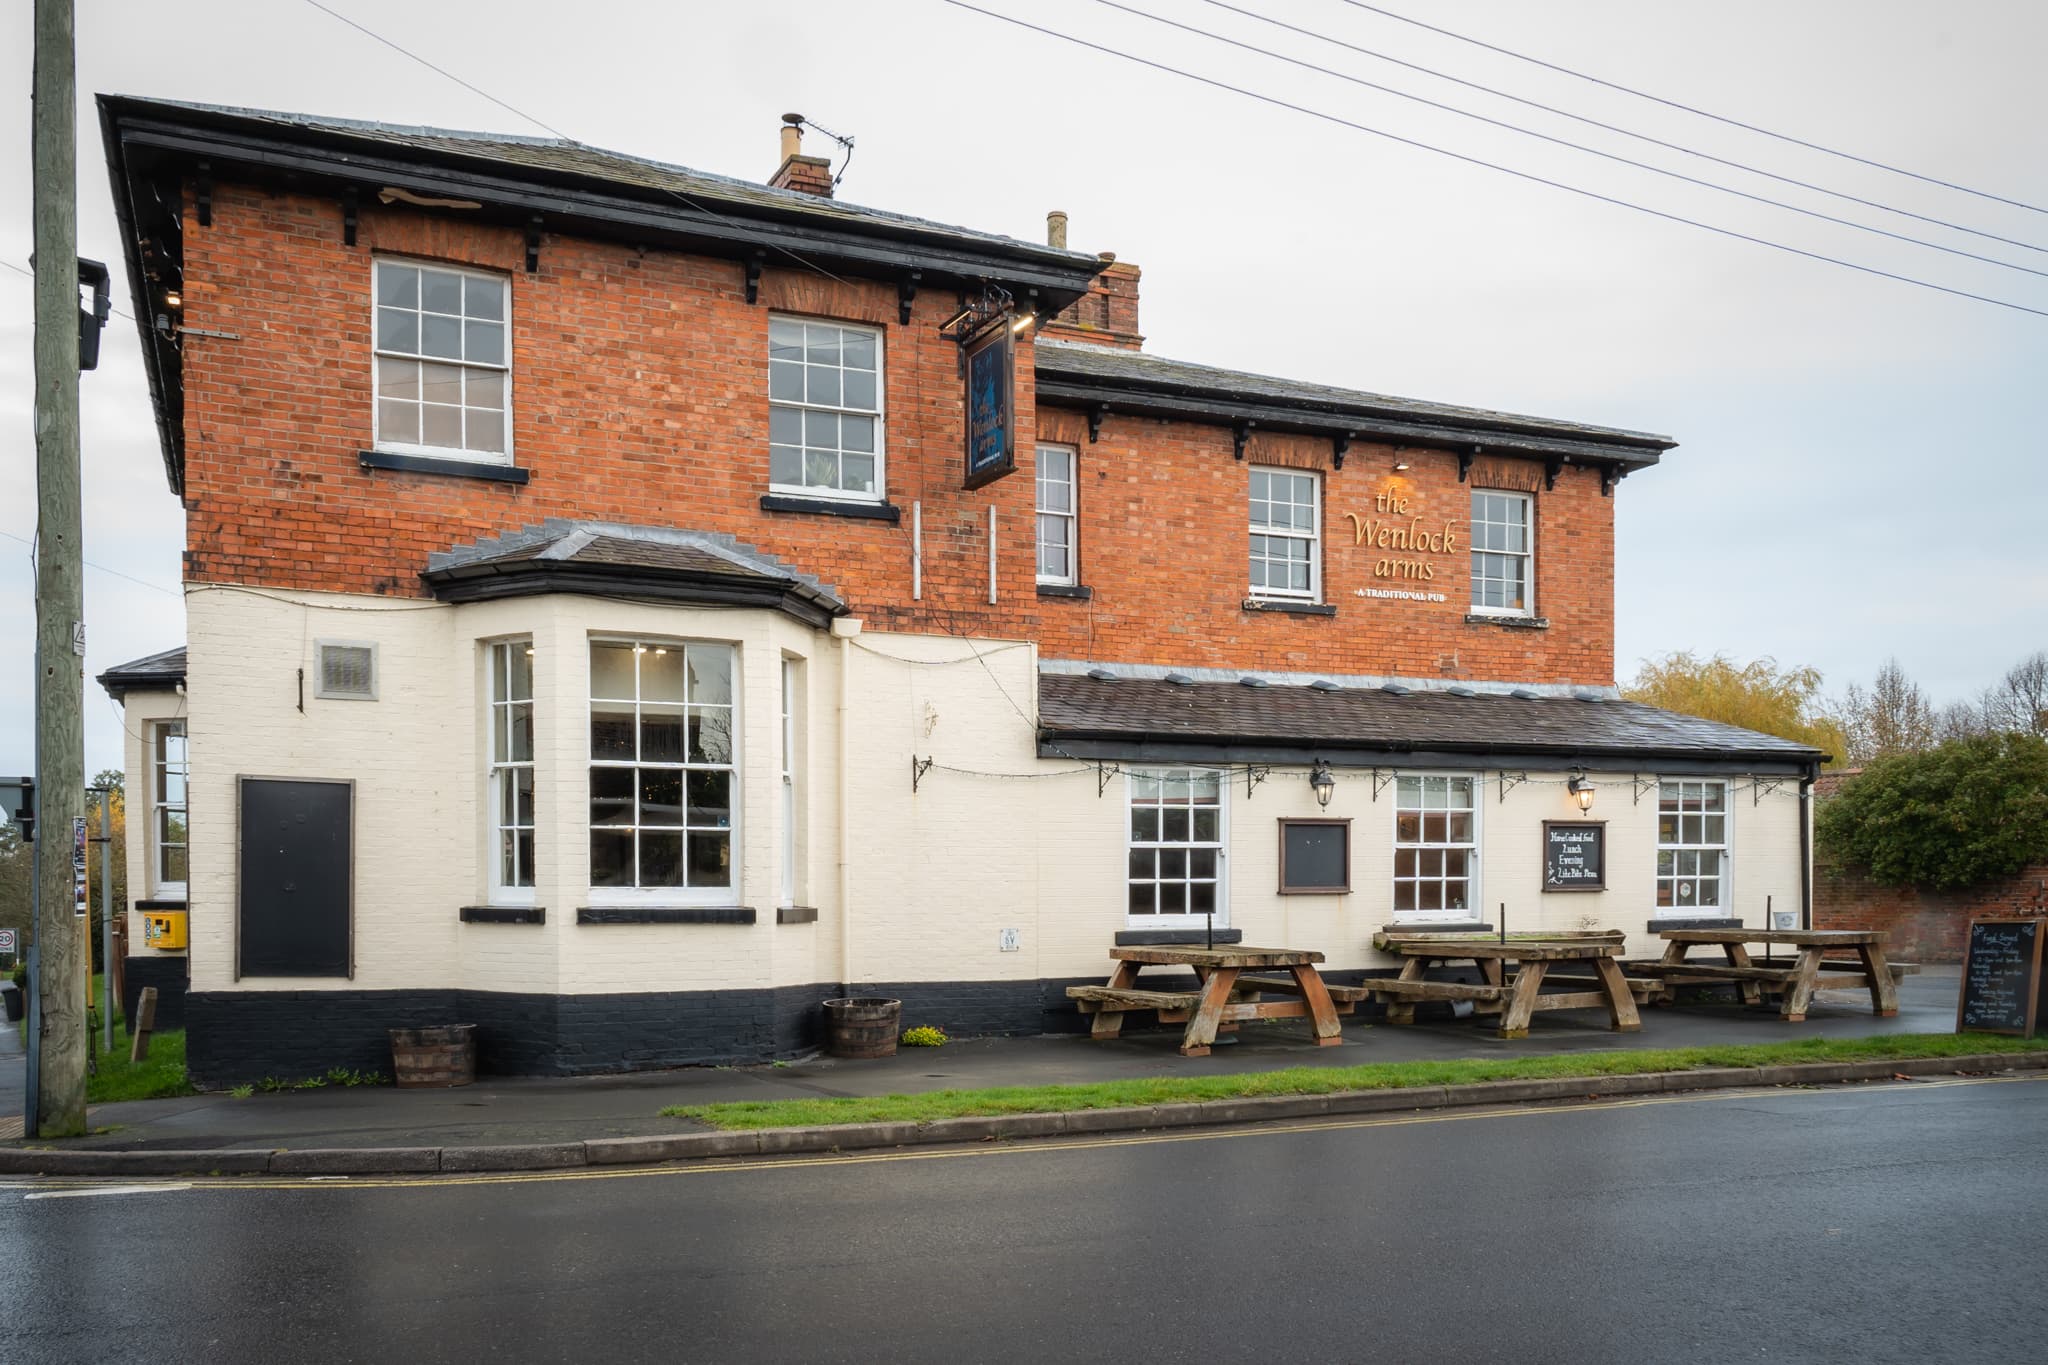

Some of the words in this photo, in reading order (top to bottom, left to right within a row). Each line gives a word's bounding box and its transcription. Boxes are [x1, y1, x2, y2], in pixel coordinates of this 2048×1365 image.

[1376, 485, 1408, 513] the
[1344, 512, 1457, 554] Wenlock
[1375, 558, 1434, 580] arms
[1366, 588, 1425, 601] TRADITIONAL
[1427, 593, 1445, 602] PUB
[1562, 844, 1582, 853] Lunch
[1559, 854, 1584, 868] Evening
